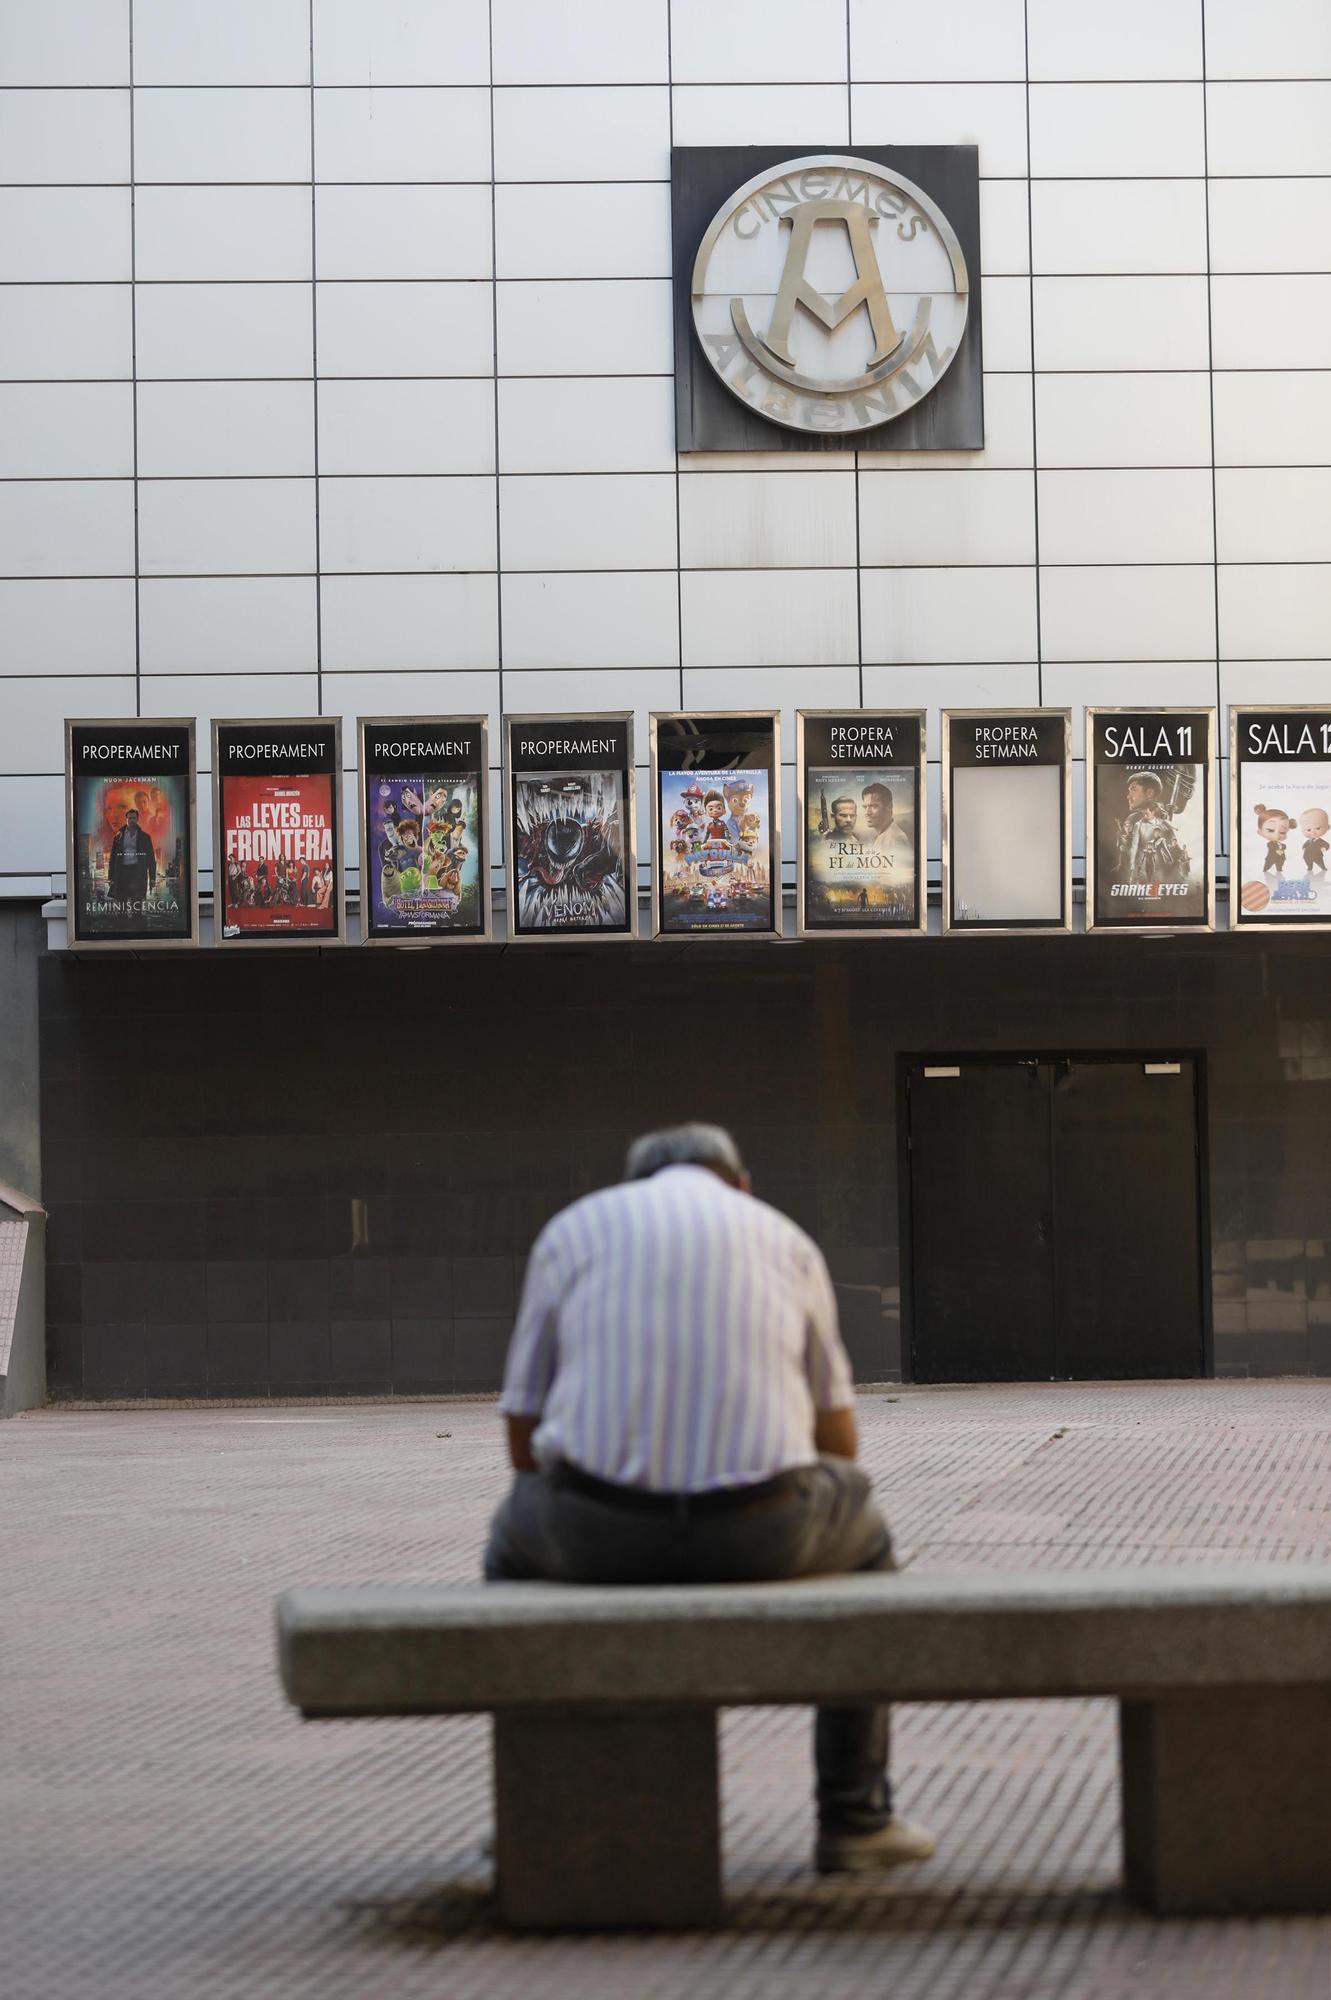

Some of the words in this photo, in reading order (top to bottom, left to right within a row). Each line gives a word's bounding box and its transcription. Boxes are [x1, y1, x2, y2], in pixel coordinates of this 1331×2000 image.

[830, 727, 894, 741] PROPERA
[975, 727, 1038, 742] PROPERA
[1104, 726, 1173, 758] SALA
[1176, 726, 1192, 757] 11
[1248, 723, 1316, 755] SALA
[82, 744, 180, 760] PROPERAMENT
[229, 743, 326, 759] PROPERAMENT
[374, 741, 471, 757] PROPERAMENT
[520, 739, 617, 755] PROPERAMENT
[830, 744, 893, 759] SETMANA
[975, 744, 1038, 759] SETMANA
[235, 816, 251, 829] LAS
[252, 802, 301, 829] LEYES
[302, 815, 314, 828] DE
[314, 814, 325, 828] LA
[226, 828, 333, 861] FRONTERA
[838, 842, 865, 856] REI
[829, 857, 844, 869] FI
[856, 852, 894, 869] MÓN
[1157, 883, 1189, 896] EYES
[85, 900, 179, 913] REMINISCENCIA
[543, 901, 596, 918] VENOM
